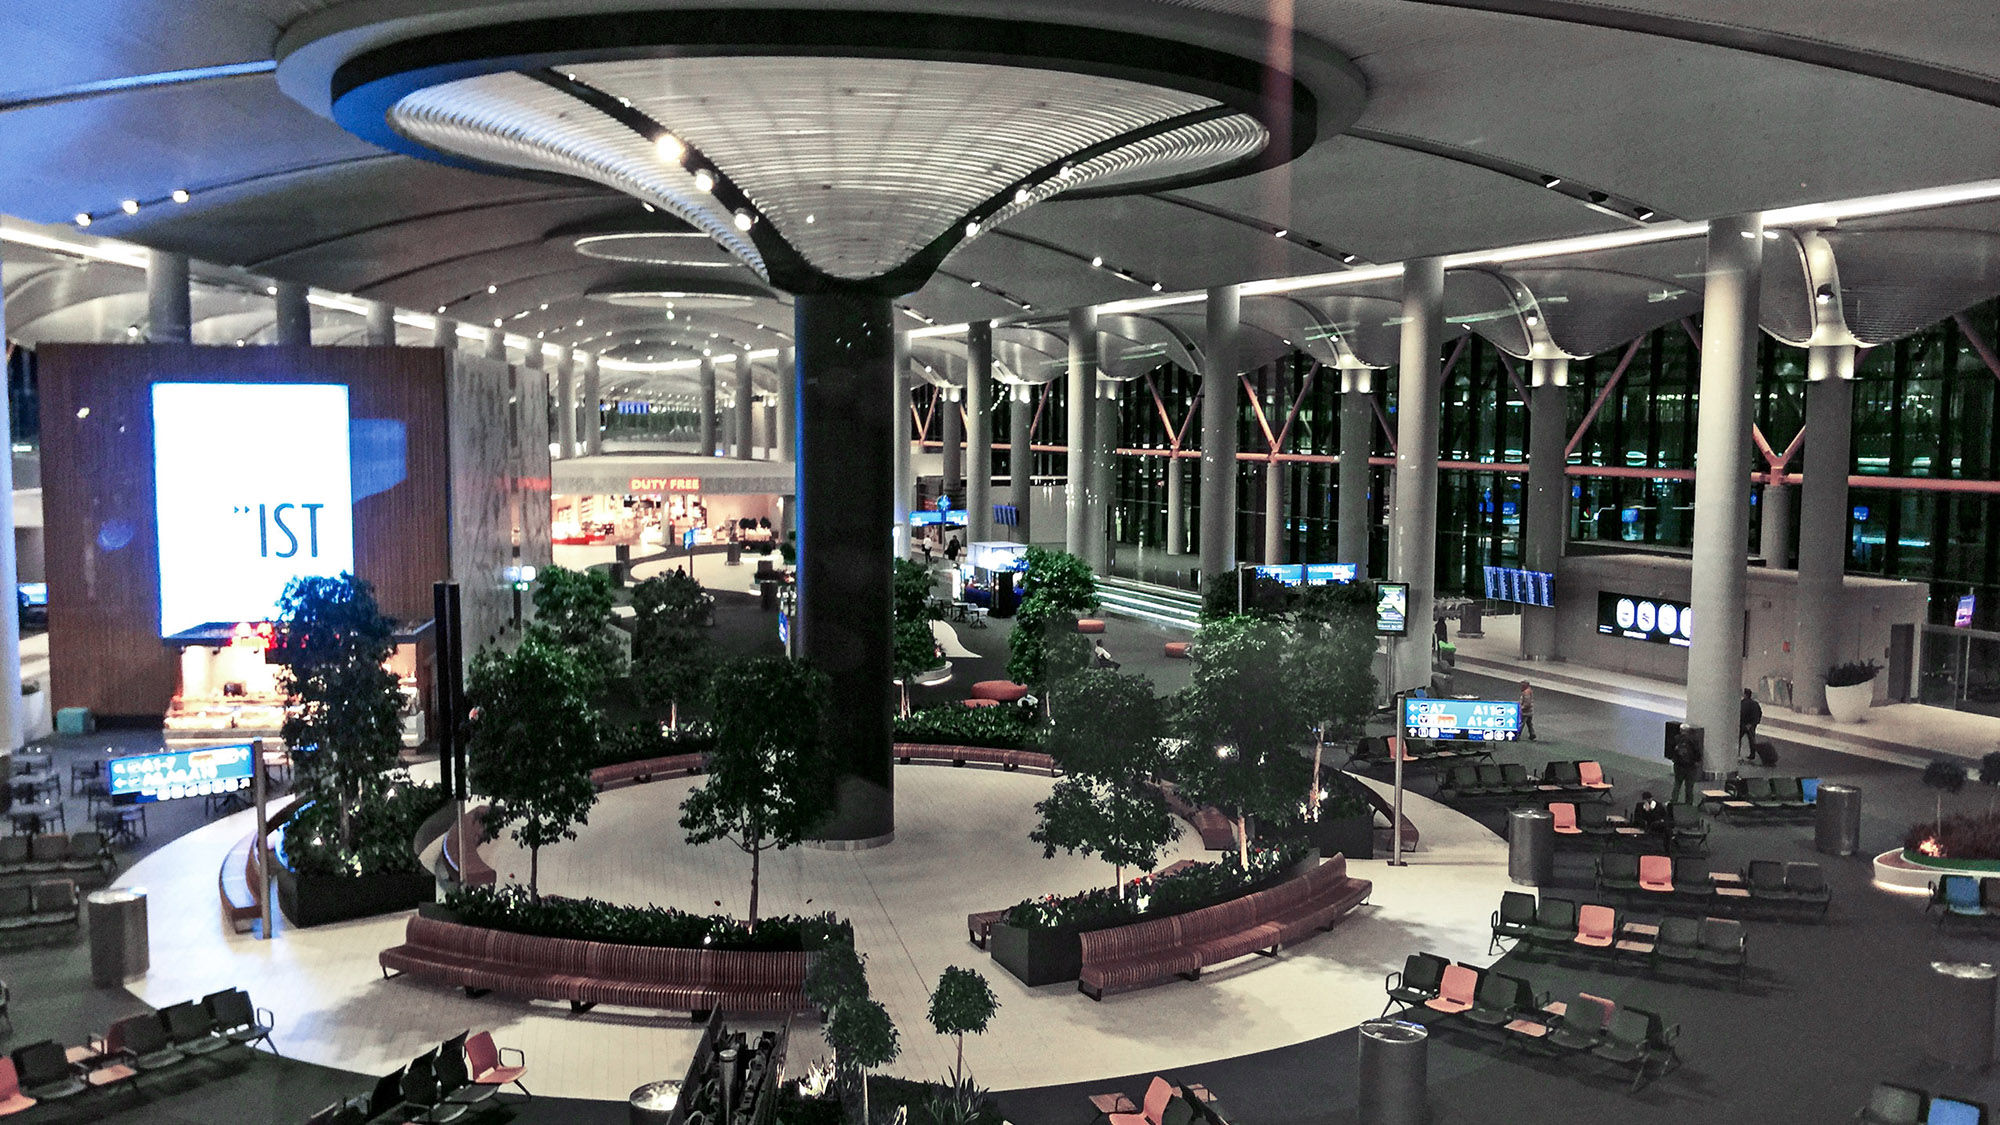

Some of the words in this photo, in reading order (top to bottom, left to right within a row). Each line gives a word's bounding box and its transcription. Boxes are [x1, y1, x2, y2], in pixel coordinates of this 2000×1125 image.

[631, 478, 667, 490] DUTY
[670, 478, 699, 490] FREE
[259, 503, 324, 558] IST
[1430, 703, 1446, 714] A7
